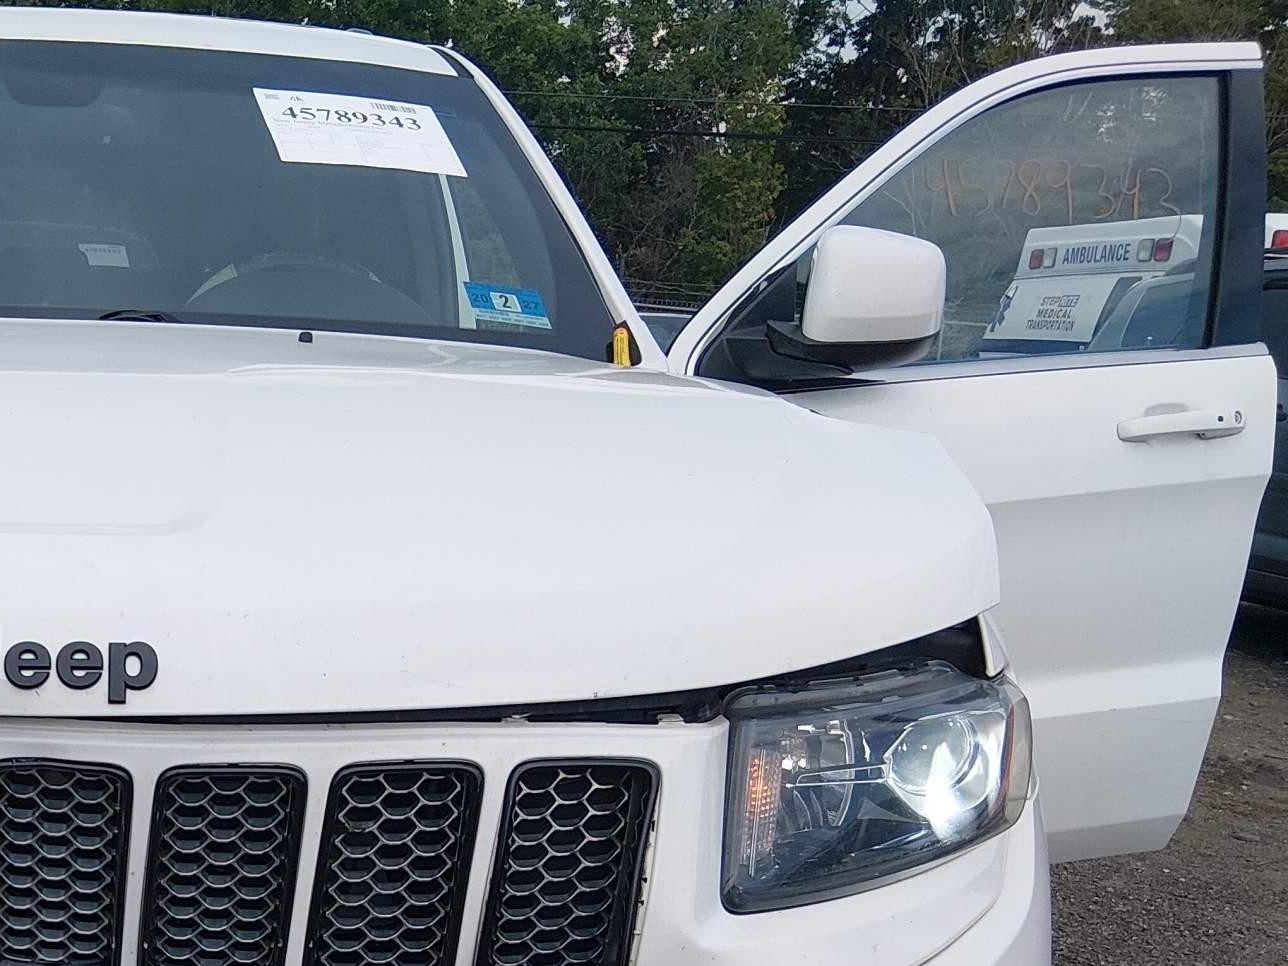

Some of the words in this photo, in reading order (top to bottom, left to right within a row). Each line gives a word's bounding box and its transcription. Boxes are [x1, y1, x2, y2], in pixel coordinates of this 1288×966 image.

[282, 106, 422, 131] 45789343
[1062, 243, 1132, 265] AMBULANCE
[499, 294, 512, 309] 2
[1036, 308, 1072, 319] MEDICAL
